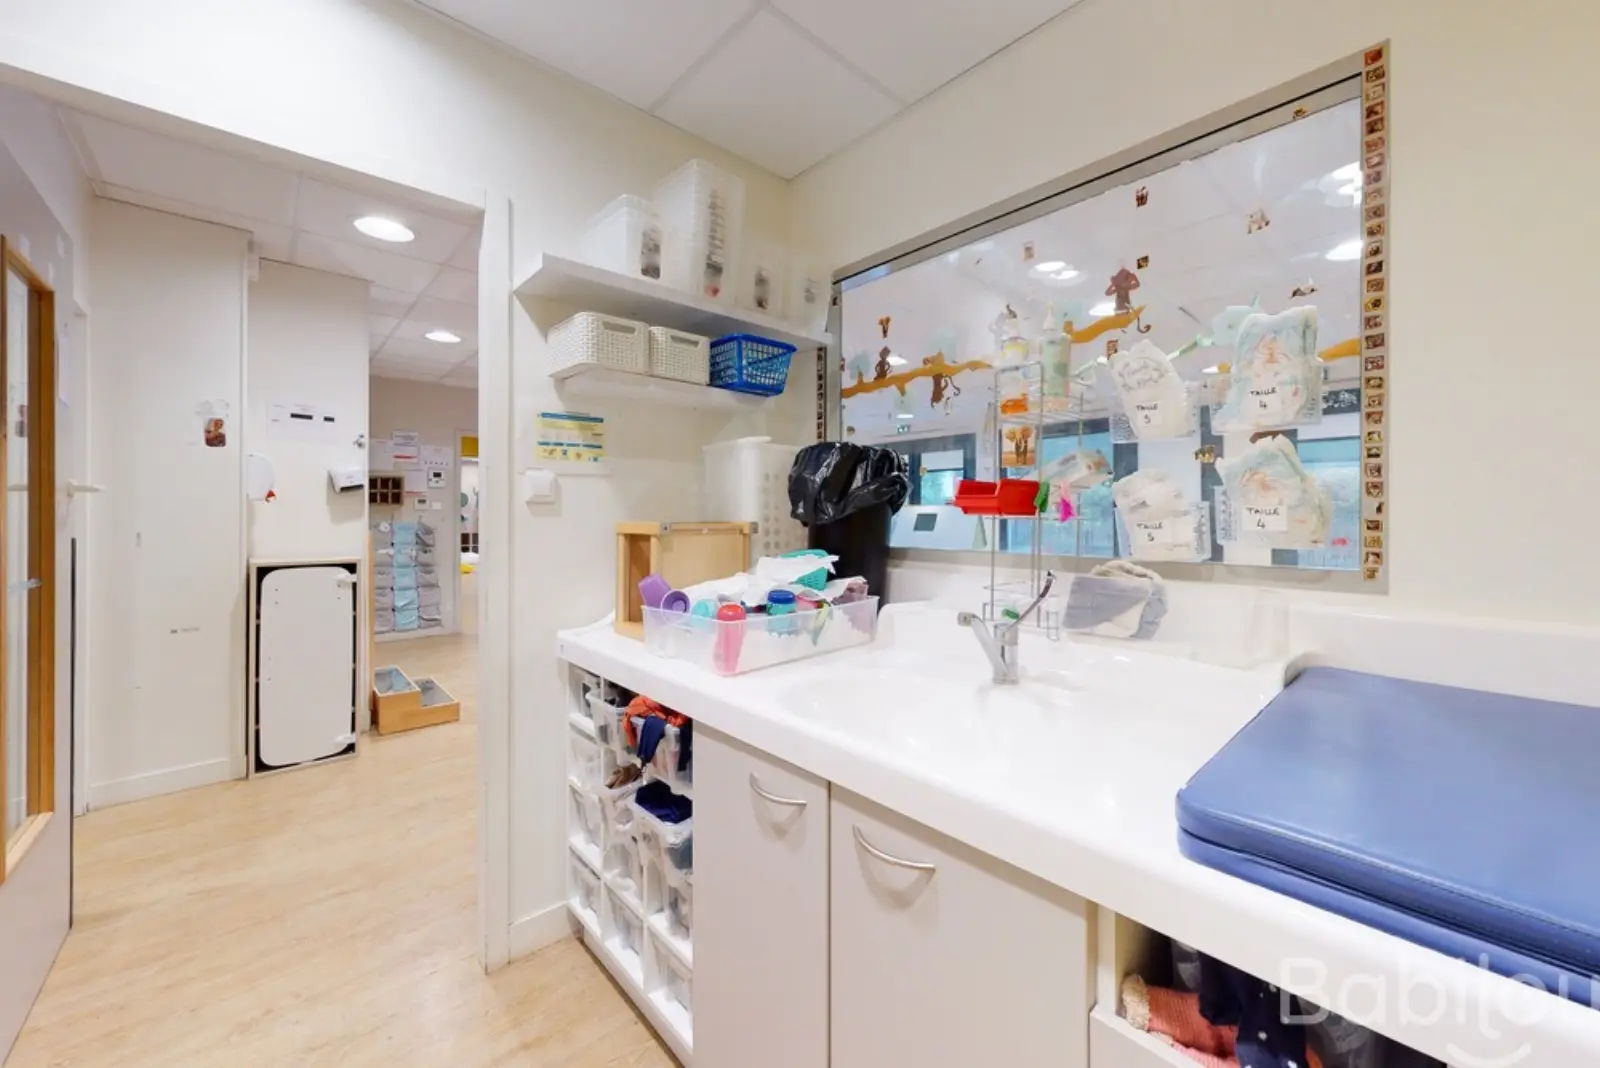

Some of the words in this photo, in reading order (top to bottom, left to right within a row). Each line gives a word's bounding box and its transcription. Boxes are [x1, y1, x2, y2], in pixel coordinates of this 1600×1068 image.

[1249, 386, 1277, 397] TAILLE
[1258, 399, 1268, 410] 4
[1245, 506, 1281, 516] TAILLE
[1136, 521, 1163, 530] TAILLE
[1257, 518, 1266, 529] 4
